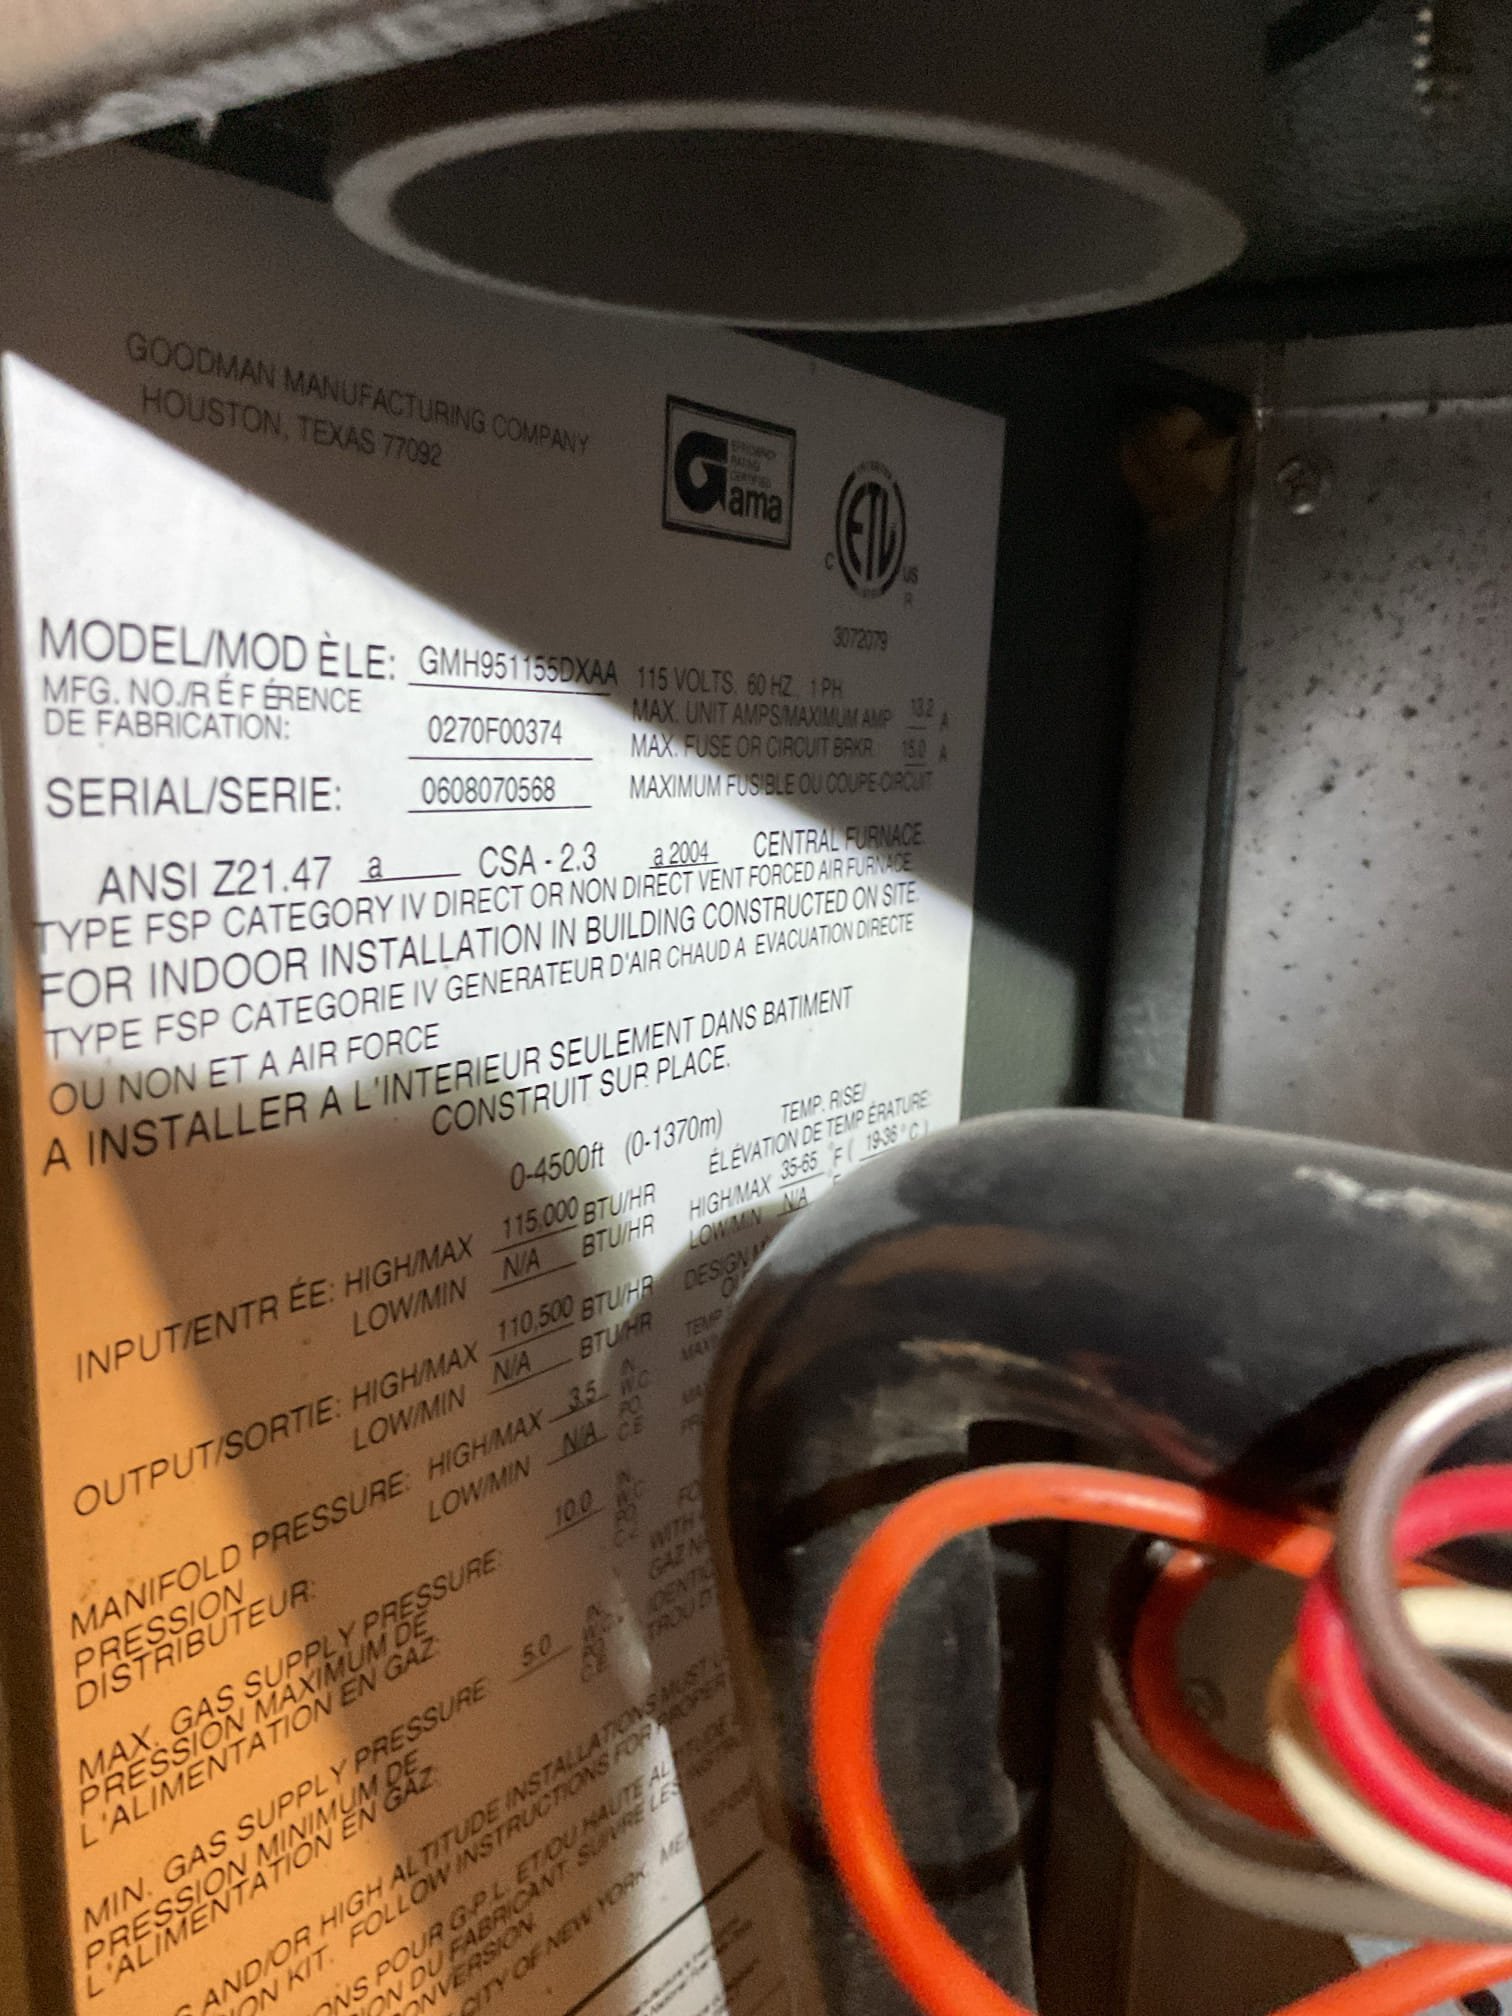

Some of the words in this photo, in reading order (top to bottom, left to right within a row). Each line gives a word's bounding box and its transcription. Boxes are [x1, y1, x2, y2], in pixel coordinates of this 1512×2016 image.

[127, 331, 275, 388] GOODMAN
[283, 369, 486, 435] MANUFACTURING
[492, 413, 590, 453] COMPANY
[141, 385, 288, 441] HOUSTON,
[298, 414, 376, 455] TEXAS
[383, 431, 442, 466] 77092
[419, 646, 619, 686] GMH951155DXAA
[638, 665, 669, 691] 115
[747, 672, 766, 696] 60
[821, 676, 843, 699] PH
[833, 625, 888, 651] 3072079
[43, 675, 121, 706] MFG.
[45, 709, 87, 737] DE
[98, 710, 290, 740] FABRICATION:
[427, 714, 563, 745] 0270F00374
[632, 698, 679, 725] MAX.
[686, 701, 729, 726] UNIT
[862, 708, 894, 730] AMP
[629, 772, 722, 800] MAXIMUM
[727, 772, 795, 797] FUSIBLE
[799, 772, 824, 796] OU
[630, 732, 678, 758] MAX.
[685, 733, 731, 758] FUSE
[736, 734, 762, 759] OR
[766, 736, 831, 759] CIRCUIT
[46, 774, 342, 818] SERIAL/SERIE:
[421, 775, 556, 805] 0608070568
[98, 861, 198, 904] ANSI
[213, 855, 332, 897] Z21.47
[366, 856, 384, 880] a
[478, 844, 536, 878] CSA
[753, 829, 839, 859] CENTRAL
[36, 915, 132, 955] TYPE
[146, 909, 211, 945] FSP
[224, 894, 396, 938] CATEGORY
[401, 892, 426, 921] IV
[434, 884, 523, 919] DIRECT
[530, 882, 563, 909] OR
[569, 876, 617, 905] NON
[623, 869, 694, 900] DIRECT
[699, 866, 745, 893] VENT
[748, 861, 815, 889] FORCED
[818, 858, 843, 881] AIR
[847, 852, 912, 877] FURNACE
[40, 964, 132, 1008] FOR
[149, 947, 308, 999] INDOOR
[321, 919, 541, 978] INSTALLATION
[552, 918, 577, 949] IN
[586, 904, 696, 945] BUILDING
[703, 888, 848, 931] CONSTRUCTED
[853, 886, 879, 910] ON
[45, 1018, 142, 1060] TYPE
[156, 1009, 220, 1045] FSP
[232, 983, 406, 1034] CATEGORIE
[413, 978, 438, 1007] IV
[446, 956, 604, 1003] GENERATEUR
[610, 949, 662, 979] D'AIR
[667, 939, 730, 969] CHAUD
[734, 940, 746, 958] A
[755, 922, 853, 956] EVACUATION
[857, 912, 914, 941] DIRECTE
[42, 1138, 71, 1177] A
[88, 1092, 309, 1168] INSTALLER
[319, 1085, 342, 1119] A
[354, 1046, 541, 1112] L'INTERIEUR
[549, 1016, 696, 1071] SEULEMENT
[701, 1003, 757, 1039] DANS
[763, 985, 854, 1026] BATIMENT
[49, 1073, 105, 1115] OU
[118, 1064, 196, 1105] NON
[209, 1054, 249, 1087] ET
[259, 1050, 279, 1080] A
[287, 1040, 336, 1076] AIR
[346, 1023, 440, 1063] FORCE
[432, 1073, 593, 1136] CONSTRUIT
[600, 1062, 649, 1097] SUR
[656, 1044, 731, 1087] PLACE.
[782, 1095, 826, 1124] TEMP.
[510, 1143, 605, 1192] 0-4500ft
[624, 1109, 725, 1166] (0-1370m)
[689, 1173, 772, 1222] HIGH/MAX
[780, 1150, 818, 1180] 35-65
[866, 1126, 898, 1151] 19-36
[708, 1130, 797, 1175] ÉLÉVATION
[802, 1121, 823, 1147] DE
[344, 1234, 475, 1299] HIGH/MAX
[582, 1181, 656, 1226] BTU/HR
[683, 1251, 746, 1292] DESIGN
[688, 1206, 763, 1250] LOW/MIN
[351, 1275, 470, 1338] LOW/MIN
[502, 1250, 541, 1282] N/A
[582, 1214, 656, 1259] BTU/HR
[72, 1393, 342, 1517] OUTPUT/SORTIE:
[351, 1340, 481, 1414] HIGH/MAX
[579, 1274, 654, 1322] BTU/HR
[352, 1383, 467, 1453] LOW/MIN
[492, 1355, 531, 1386] N/A
[579, 1311, 654, 1361] BTU/HR
[428, 1455, 531, 1523] LOW/MIN
[562, 1421, 598, 1456] N/A
[70, 1543, 241, 1641] MANIFOLD
[251, 1468, 411, 1560] PRESSURE:
[427, 1407, 543, 1482] HIGH/MAX
[74, 1577, 244, 1679] PRESSION
[75, 1578, 317, 1711] DISTRIBUTEUR:
[78, 1722, 160, 1785] MAX.
[171, 1683, 236, 1736] GAS
[243, 1620, 356, 1700] SUPPLY
[79, 1714, 245, 1819] PRESSION
[254, 1631, 387, 1724] MAXIMUM
[395, 1609, 429, 1647] DE
[81, 1694, 333, 1850] L'ALIMENTATION
[340, 1671, 377, 1708] EN
[83, 1876, 152, 1933] MIN.
[163, 1829, 228, 1885] GAS
[236, 1759, 348, 1842] SUPPLY
[85, 1850, 248, 1971] PRESSION
[256, 1772, 379, 1869] MINIMUM
[385, 1748, 419, 1788] DE
[86, 1827, 334, 2000] L'ALIMENTATION
[341, 1799, 377, 1843] EN
[202, 1925, 311, 2016] AND/OR
[320, 1876, 384, 1937] HIGH
[390, 1797, 499, 1890] ALTITUDE
[288, 1944, 335, 1992] KIT.
[351, 1856, 451, 1948] FOLLOW
[377, 1920, 444, 1987] POUR
[411, 1949, 443, 1991] DU
